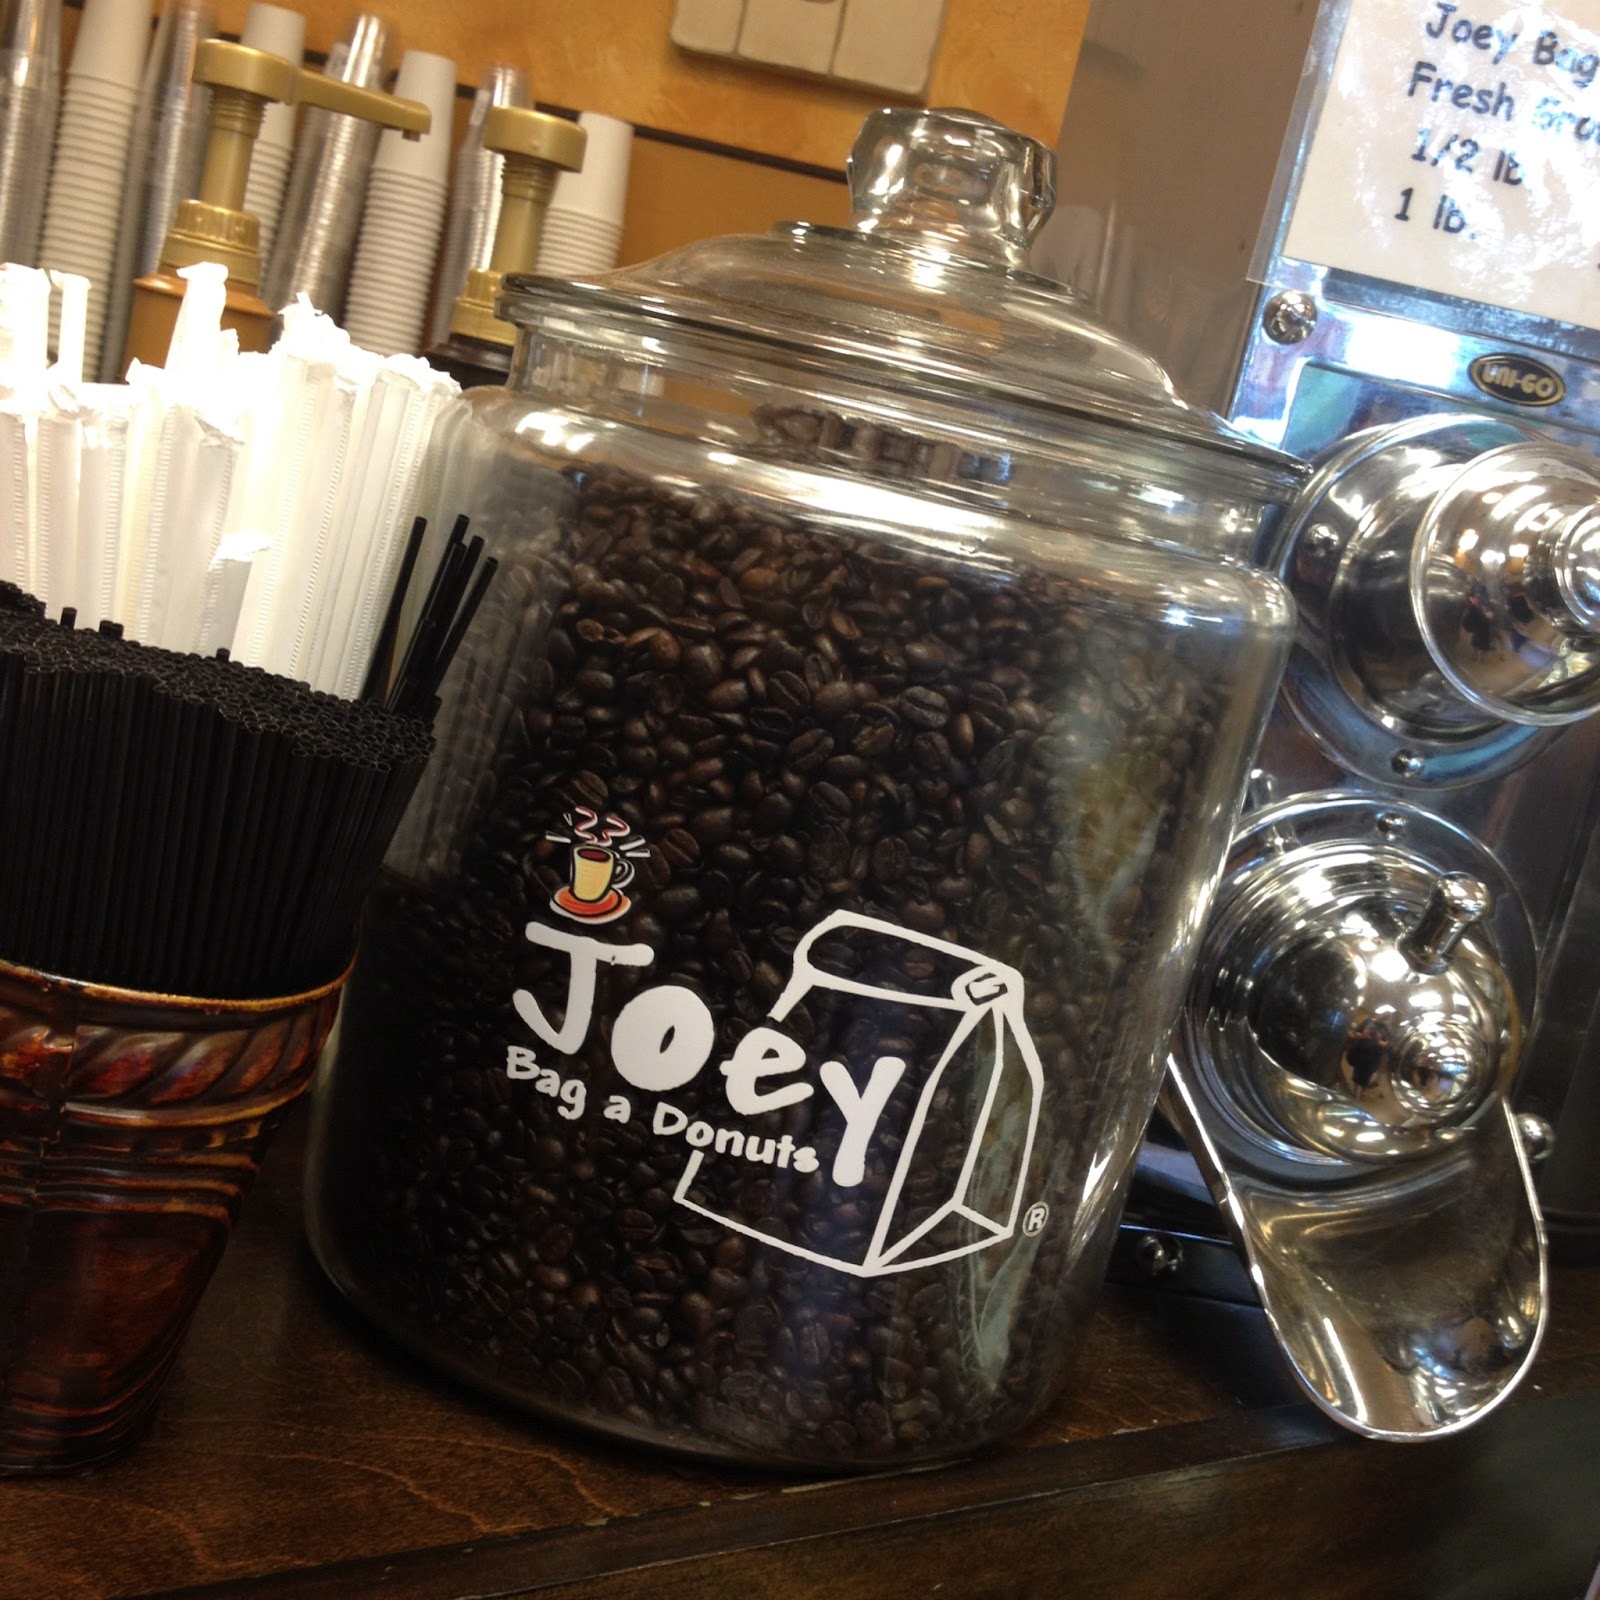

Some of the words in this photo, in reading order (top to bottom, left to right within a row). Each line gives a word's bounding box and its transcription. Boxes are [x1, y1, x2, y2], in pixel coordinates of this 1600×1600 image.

[1425, 2, 1518, 64] Joey
[1533, 30, 1599, 88] Bag
[1407, 61, 1514, 122] Fresh
[1411, 128, 1479, 174] 1/2
[1394, 187, 1413, 221] 1
[1433, 194, 1476, 240] lb.
[512, 921, 906, 1187] Joey
[506, 1045, 587, 1120] Bag
[603, 1095, 631, 1124] a
[653, 1102, 820, 1173] Donuts
